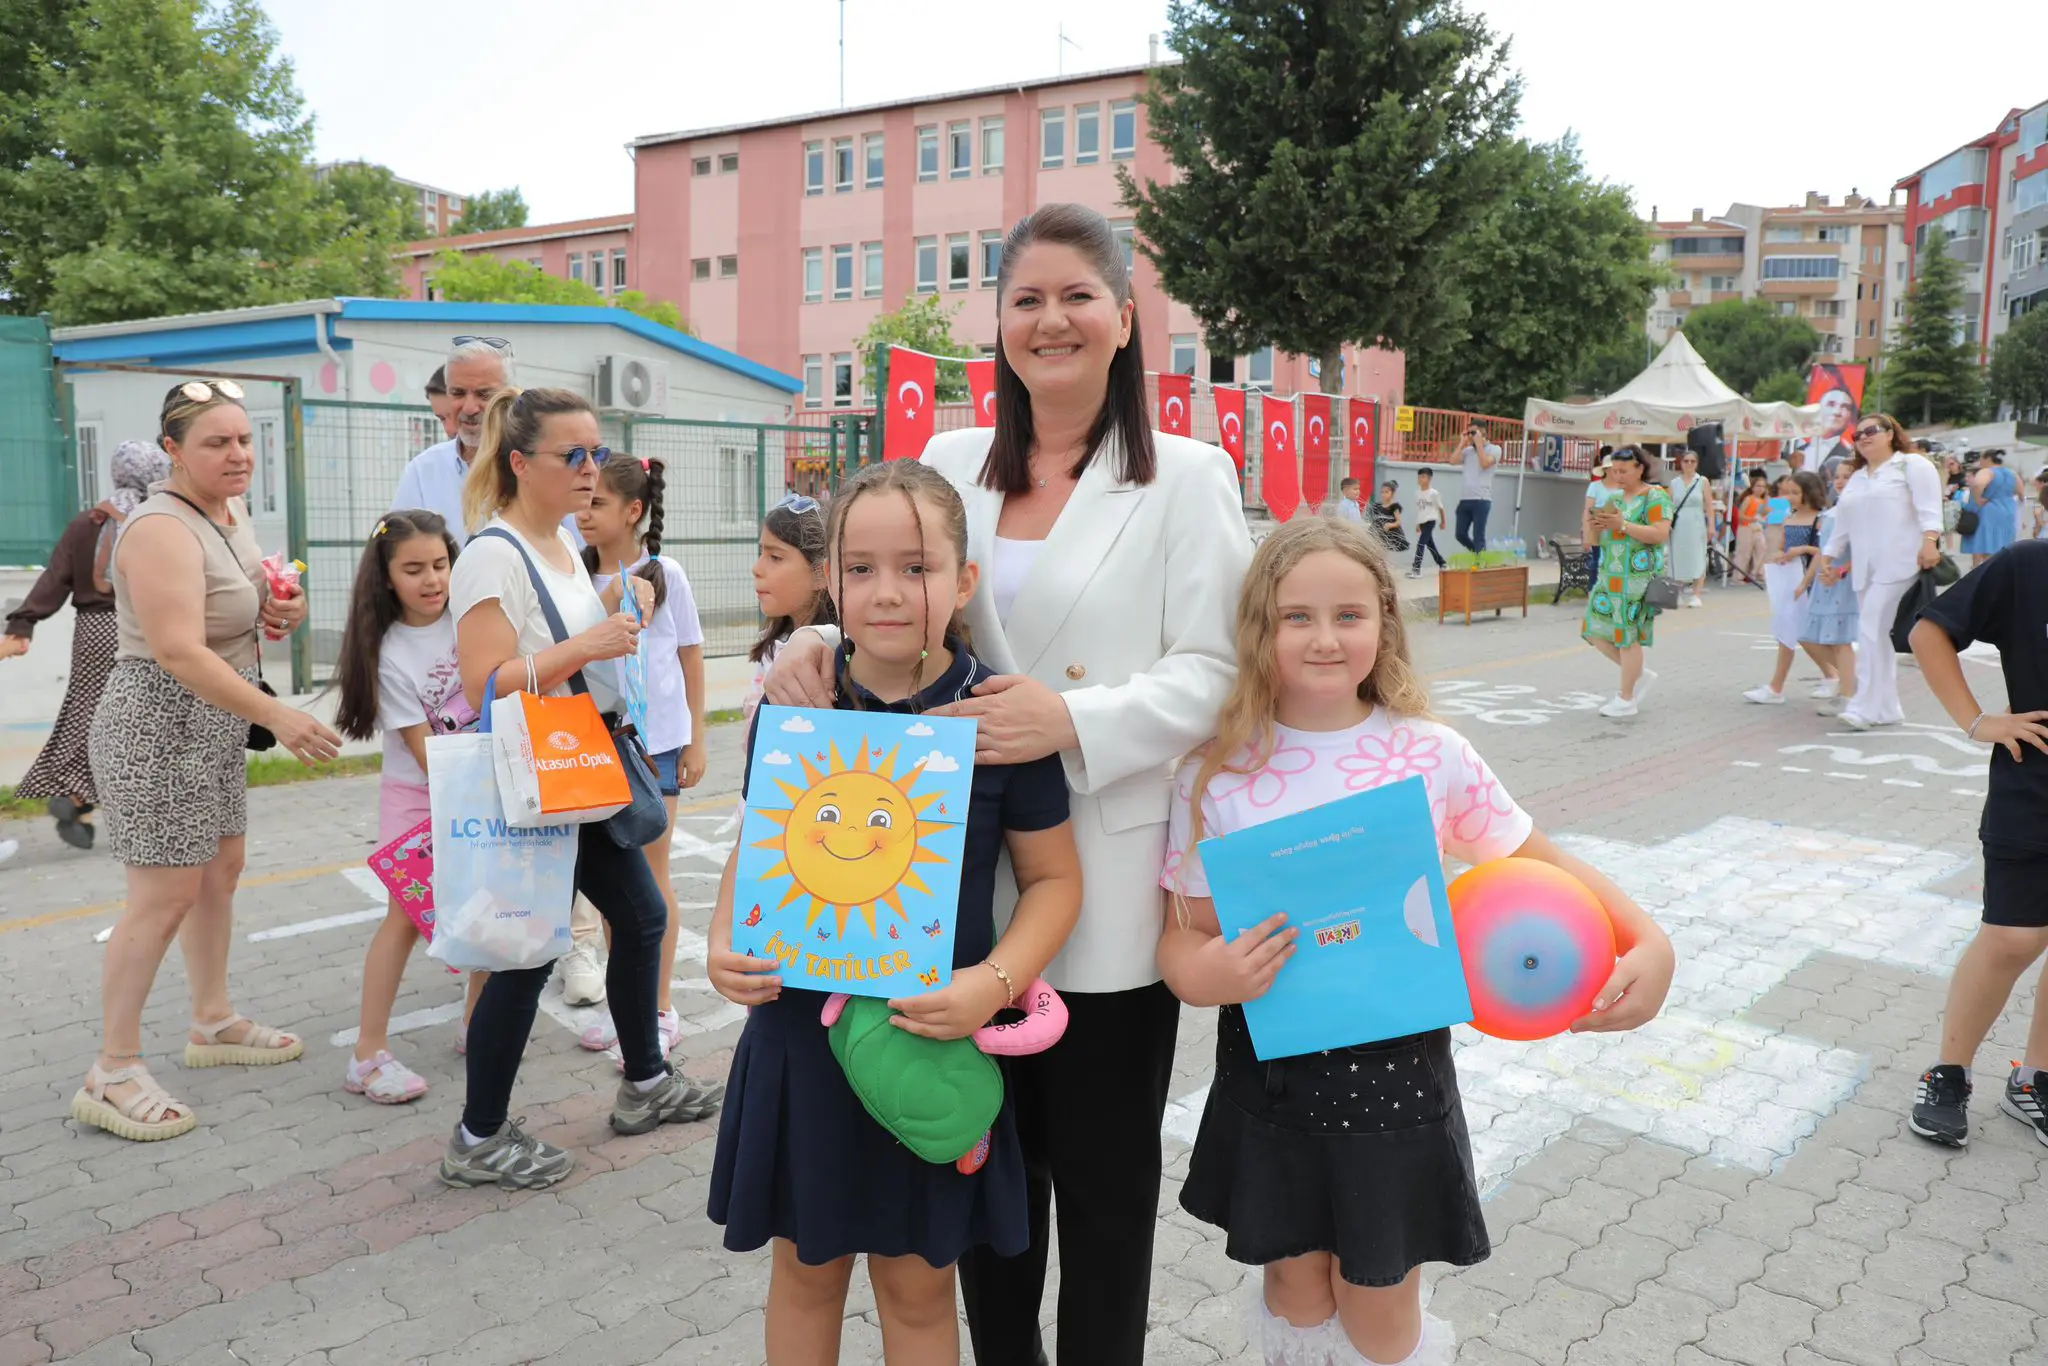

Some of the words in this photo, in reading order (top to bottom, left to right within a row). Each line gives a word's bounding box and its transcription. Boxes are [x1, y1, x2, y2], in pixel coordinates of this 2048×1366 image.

[1619, 416, 1648, 426] Edirne
[1545, 436, 1557, 467] P
[536, 757, 577, 772] Atasun
[579, 753, 613, 770] Optik
[450, 818, 482, 838] LC
[805, 949, 912, 981] TATİLLER
